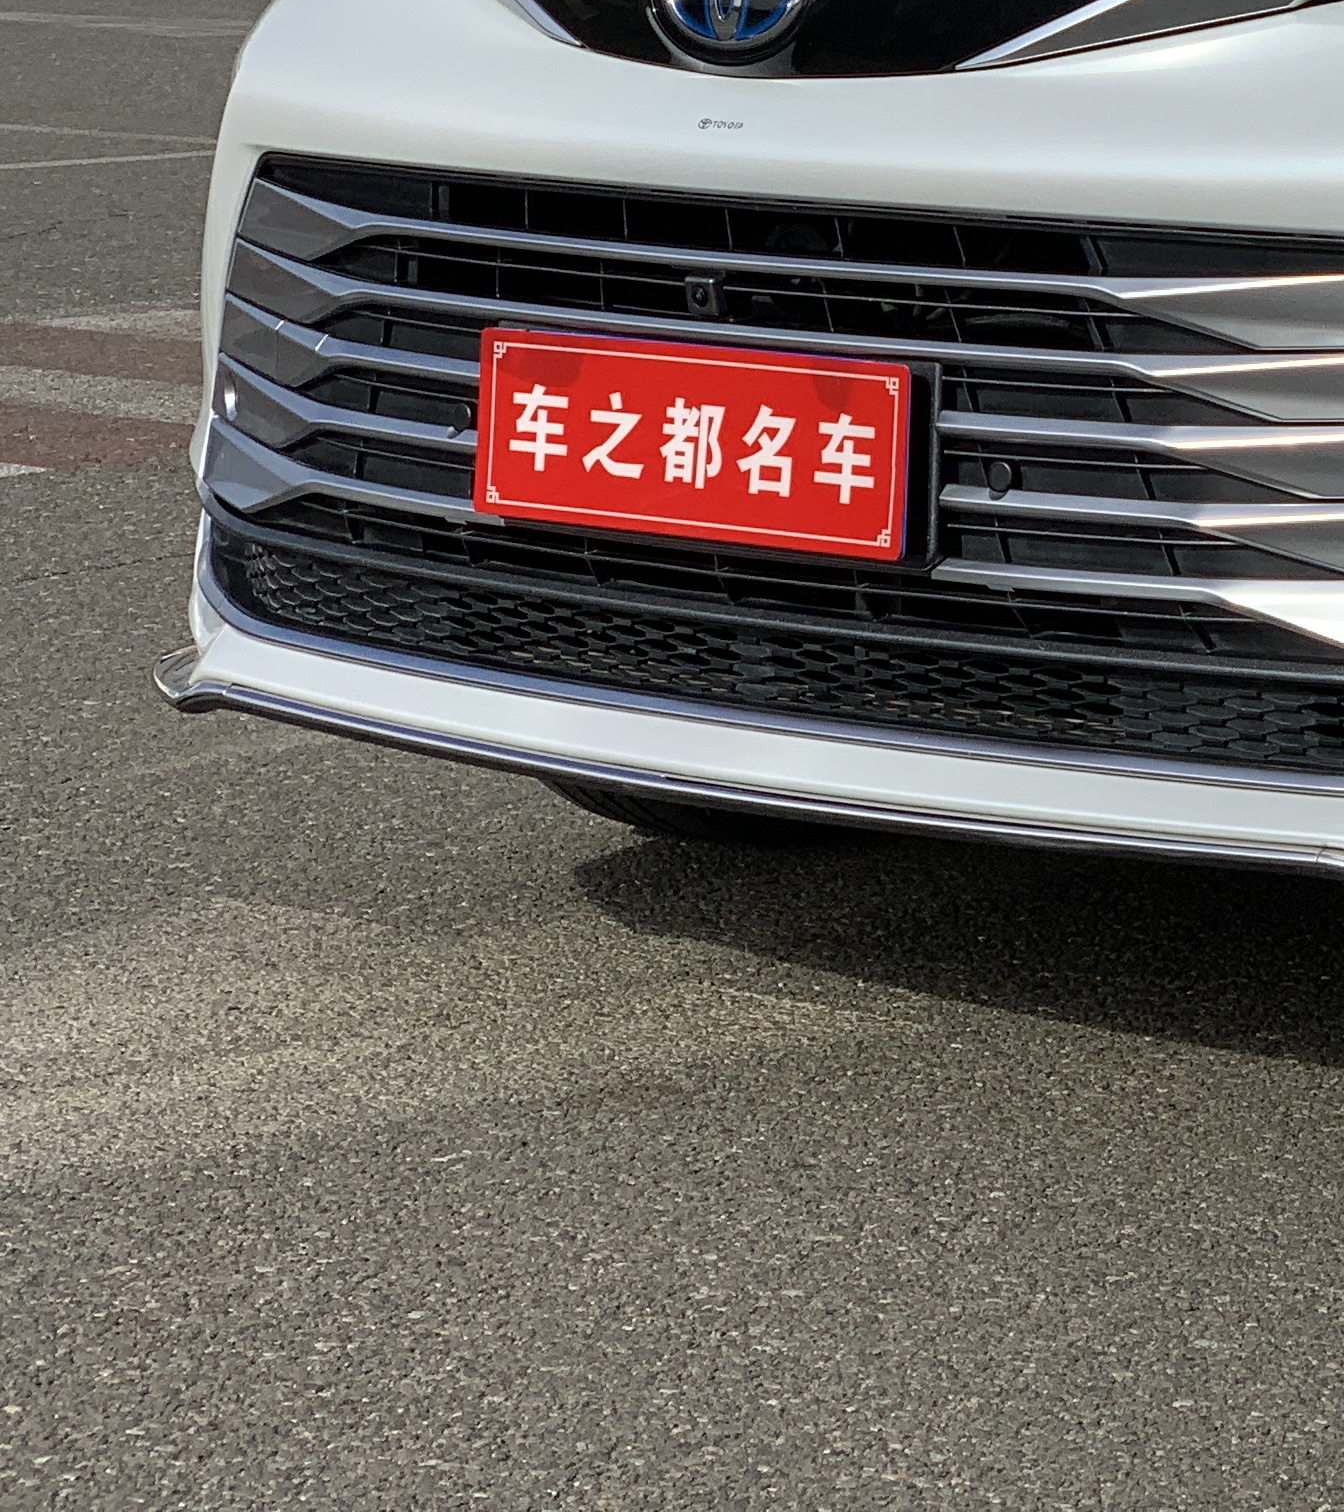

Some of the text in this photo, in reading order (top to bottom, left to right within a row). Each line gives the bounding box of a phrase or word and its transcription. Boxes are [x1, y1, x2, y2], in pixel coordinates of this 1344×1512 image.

[508, 383, 877, 505] 车之都名车
